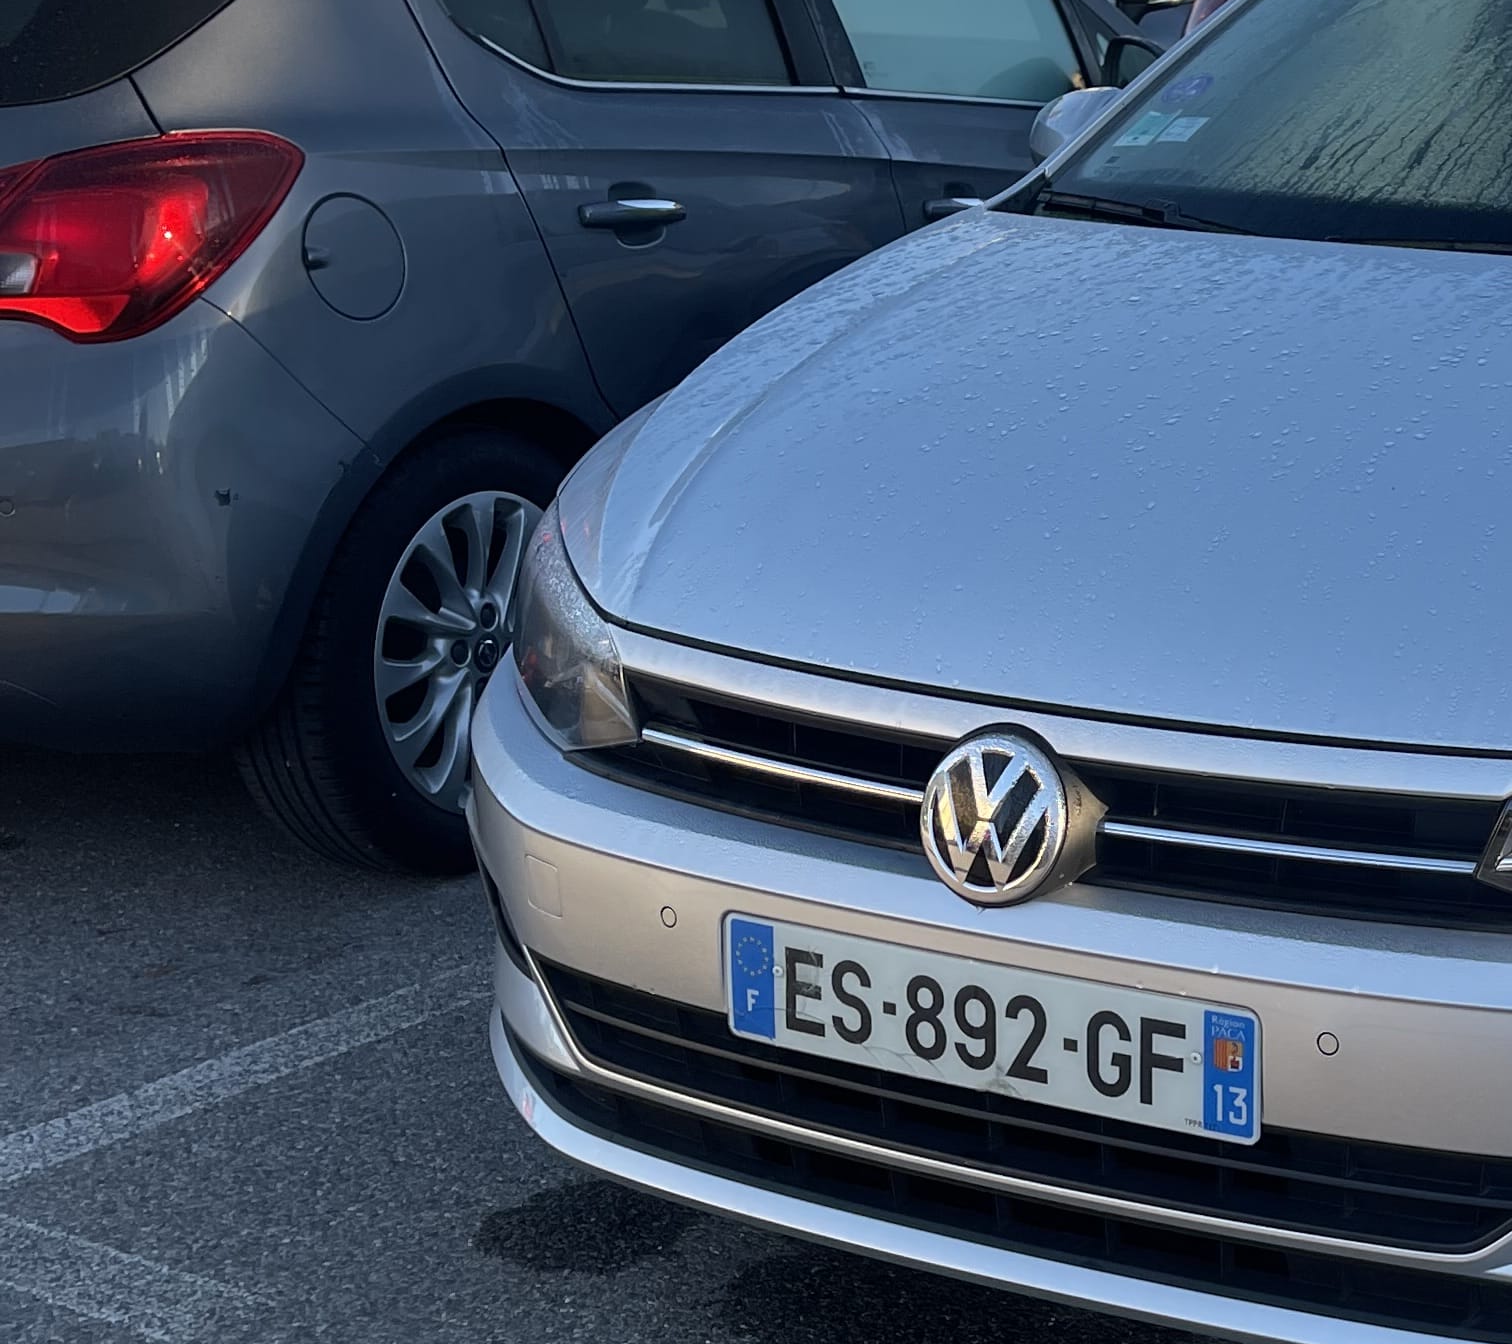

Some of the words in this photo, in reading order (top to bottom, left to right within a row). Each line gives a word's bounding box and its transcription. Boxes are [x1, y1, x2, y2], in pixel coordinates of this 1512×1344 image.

[926, 736, 1056, 896] VW
[746, 988, 760, 1012] F
[784, 945, 1188, 1106] ES-892-GF
[1211, 1025, 1246, 1043] PACA
[1213, 1083, 1248, 1127] 13
